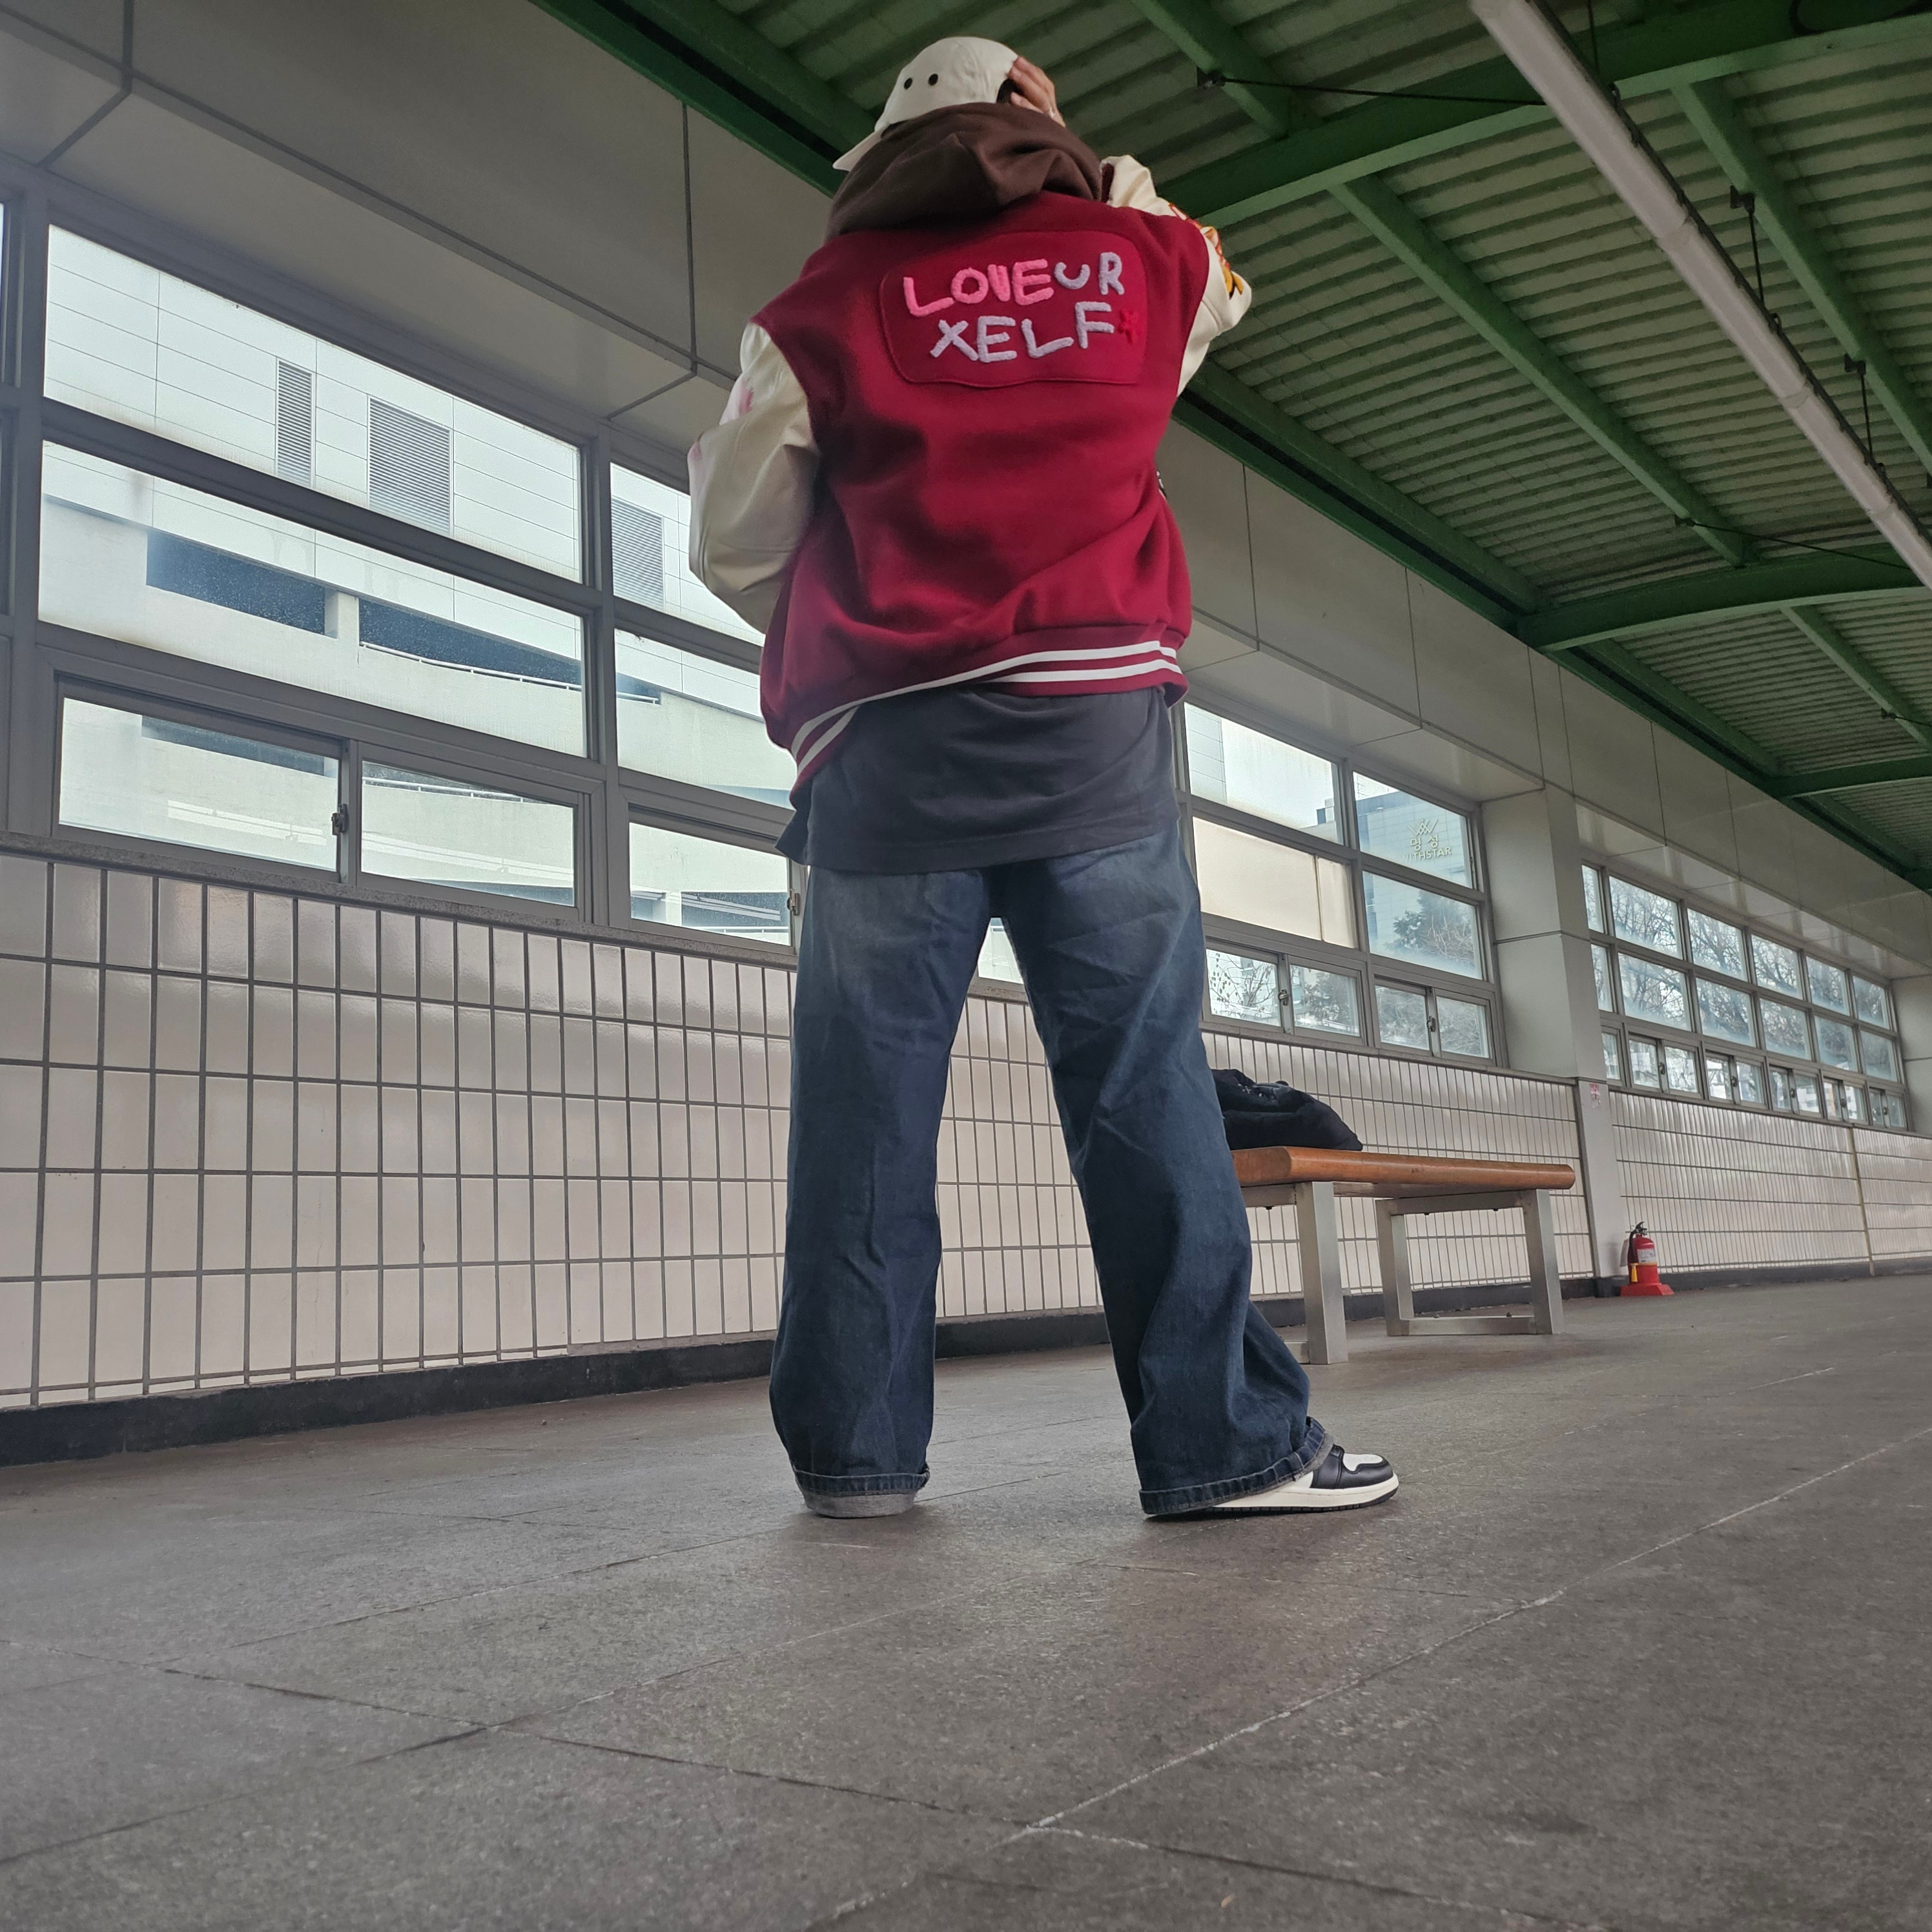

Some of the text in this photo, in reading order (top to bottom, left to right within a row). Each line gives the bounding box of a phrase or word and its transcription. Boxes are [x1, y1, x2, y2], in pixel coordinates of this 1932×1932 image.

[930, 301, 1115, 363] XELF
[1410, 833, 1439, 852] 명성
[1400, 846, 1452, 863] WITHSTAR
